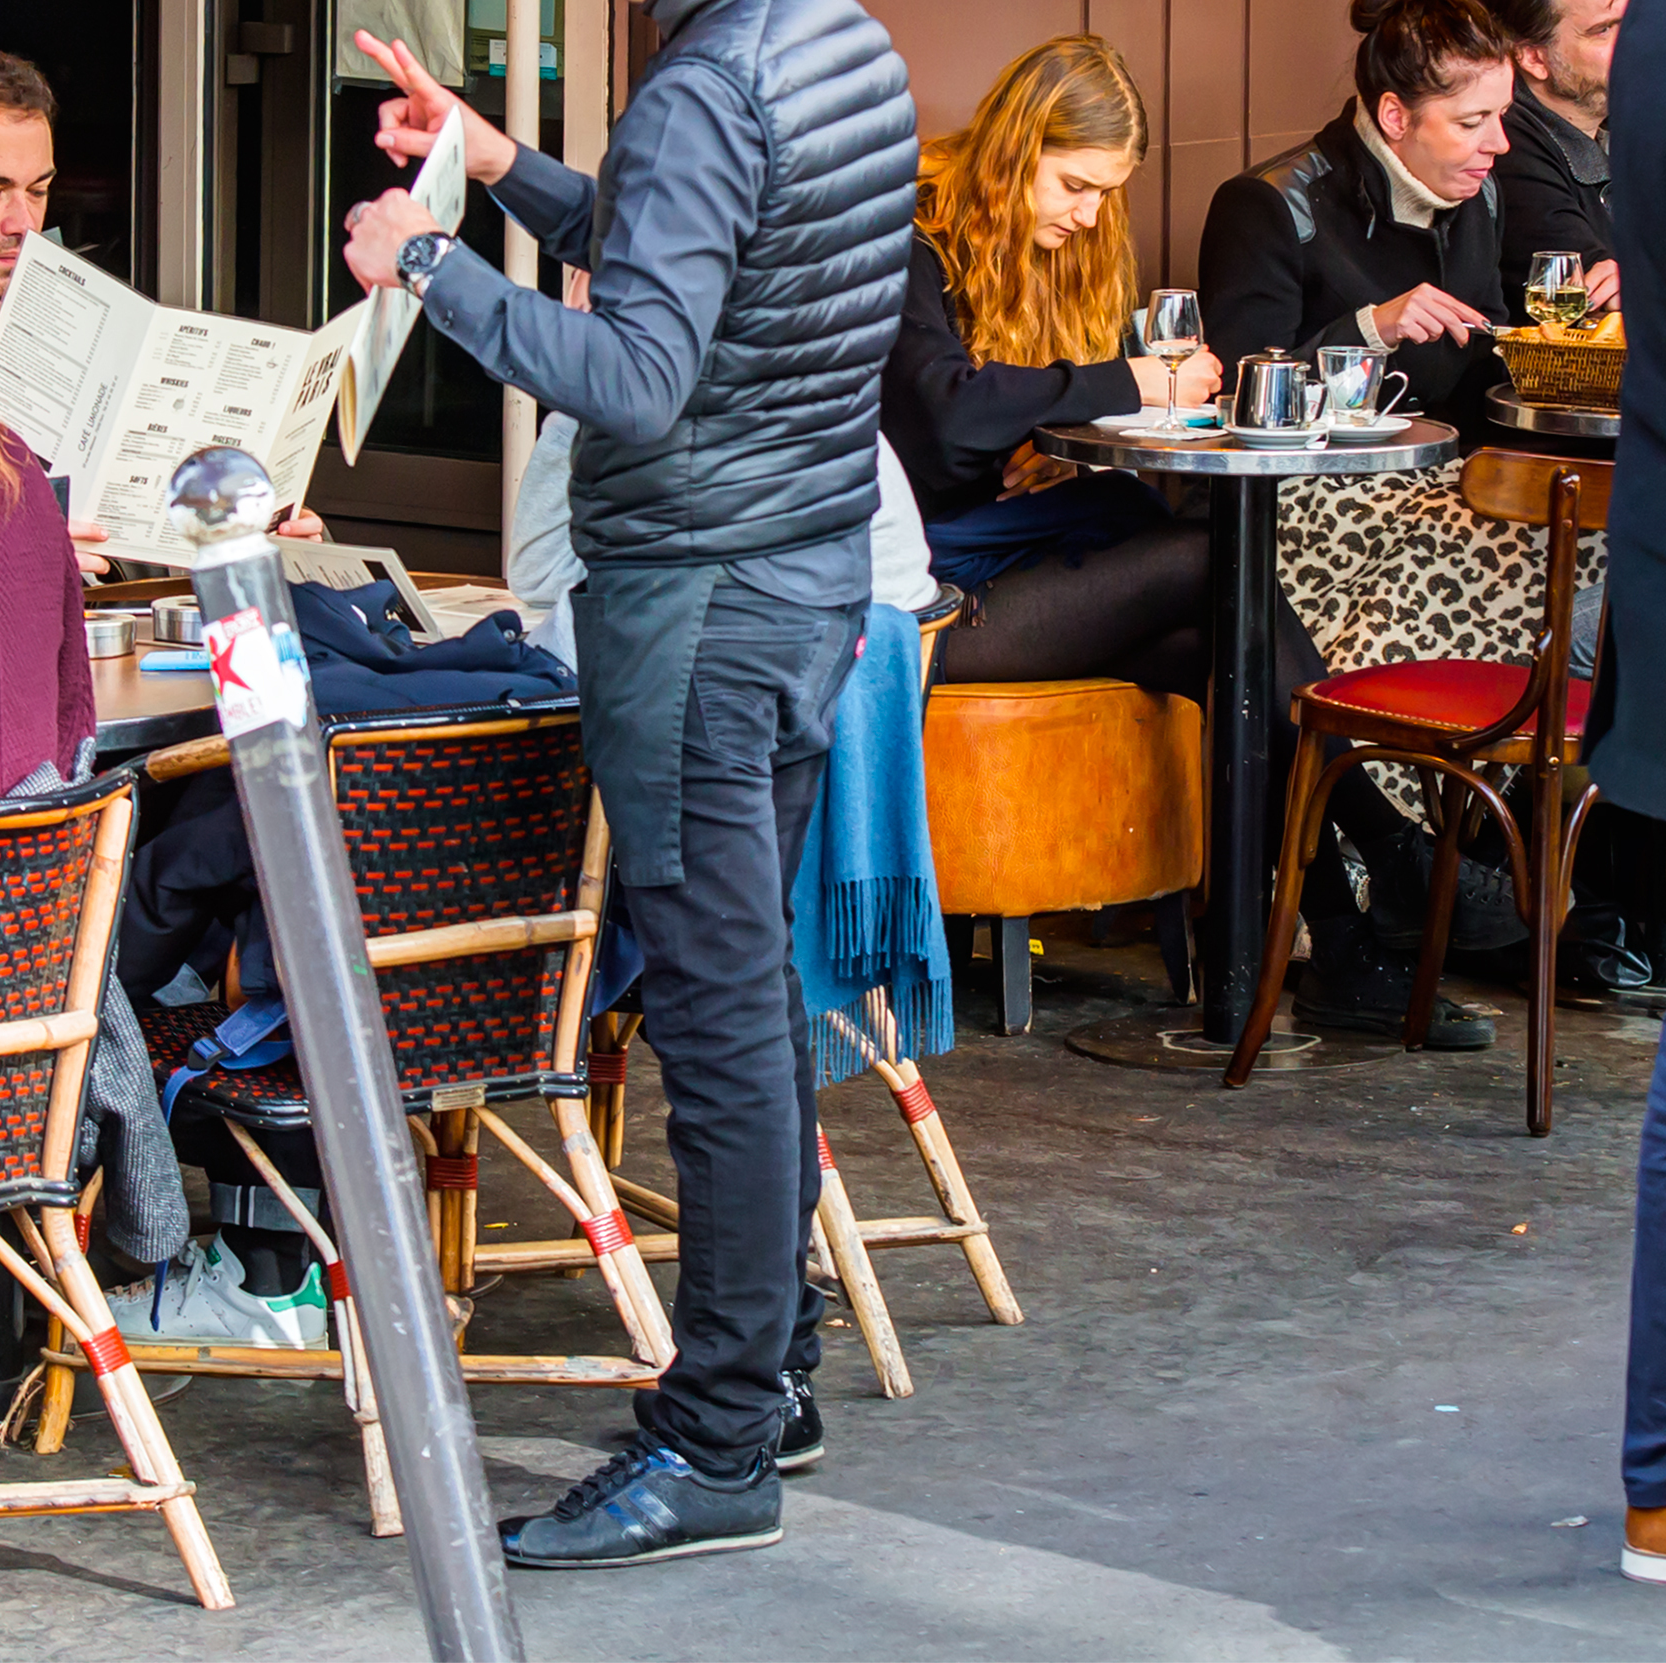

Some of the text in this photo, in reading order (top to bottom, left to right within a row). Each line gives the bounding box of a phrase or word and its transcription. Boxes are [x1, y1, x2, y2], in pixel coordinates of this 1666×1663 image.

[58, 263, 87, 286] COCKTAILS
[77, 382, 109, 453] CAFÉ LIMONADE
